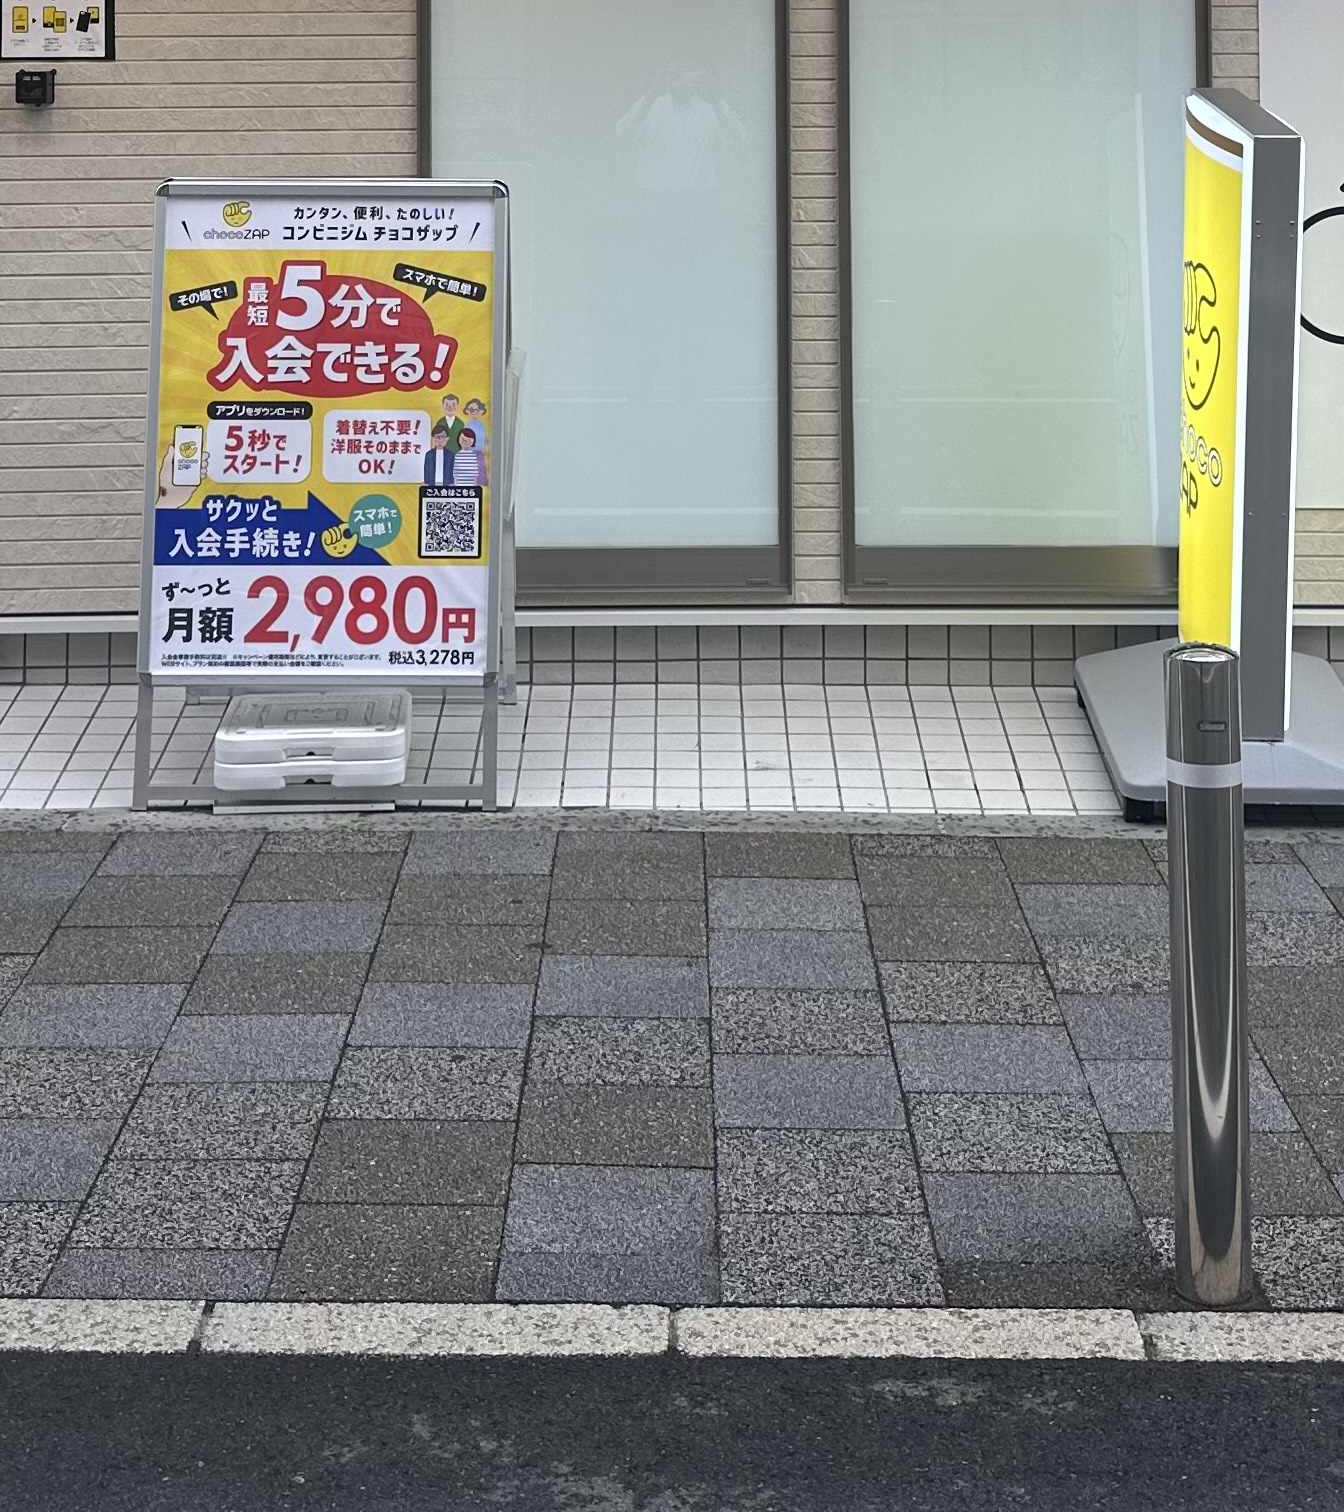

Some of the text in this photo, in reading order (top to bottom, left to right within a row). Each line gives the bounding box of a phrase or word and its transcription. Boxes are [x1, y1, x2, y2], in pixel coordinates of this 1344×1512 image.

[202, 227, 271, 241] chocoZAP
[282, 224, 459, 241] コンビニジム チョコザップ
[247, 283, 270, 326] 最短
[275, 265, 402, 331] 5分で
[215, 336, 450, 384] 入会できる!
[336, 419, 421, 436] 着替え不要!
[224, 425, 287, 452] 5秒で
[330, 439, 422, 455] 洋服そのままで
[223, 454, 303, 474] スタート!
[358, 458, 395, 475] OK!
[425, 489, 475, 497] ご入会はこちら
[206, 499, 278, 522] サクッと
[353, 506, 398, 522] スマホで
[168, 529, 316, 558] 入会手続き!
[243, 575, 476, 652] 2,980円
[162, 607, 234, 644] 月額
[388, 649, 475, 667] 税込3,278円
